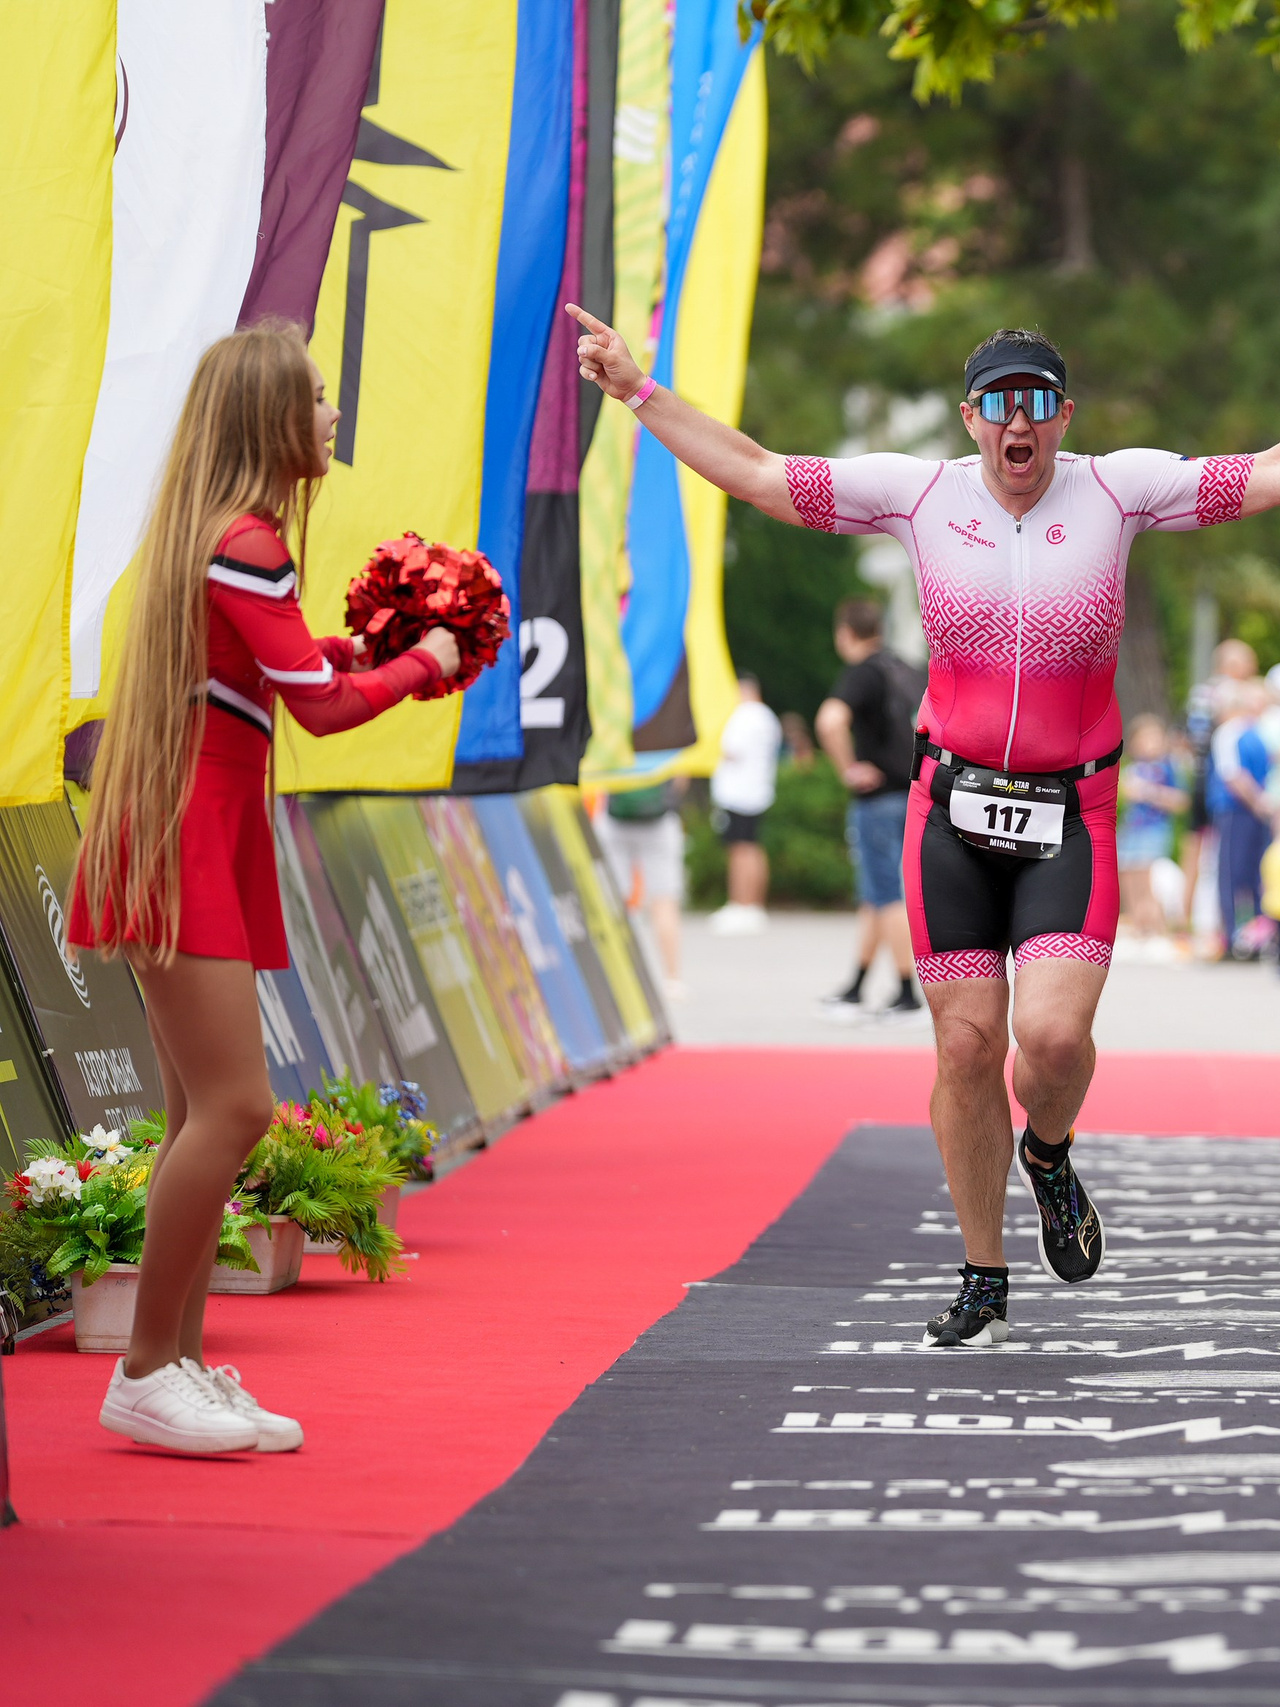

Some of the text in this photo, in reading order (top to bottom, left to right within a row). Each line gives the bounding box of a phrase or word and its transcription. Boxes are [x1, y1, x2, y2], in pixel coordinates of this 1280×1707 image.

[948, 520, 996, 549] KOPENKO
[993, 777, 1009, 787] IRON
[1013, 780, 1030, 790] STAR
[983, 803, 1032, 834] 117
[989, 838, 1017, 851] MIHAIL
[781, 1411, 1113, 1430] IRON
[713, 1508, 1100, 1529] IRON
[612, 1618, 1079, 1659] IRON
